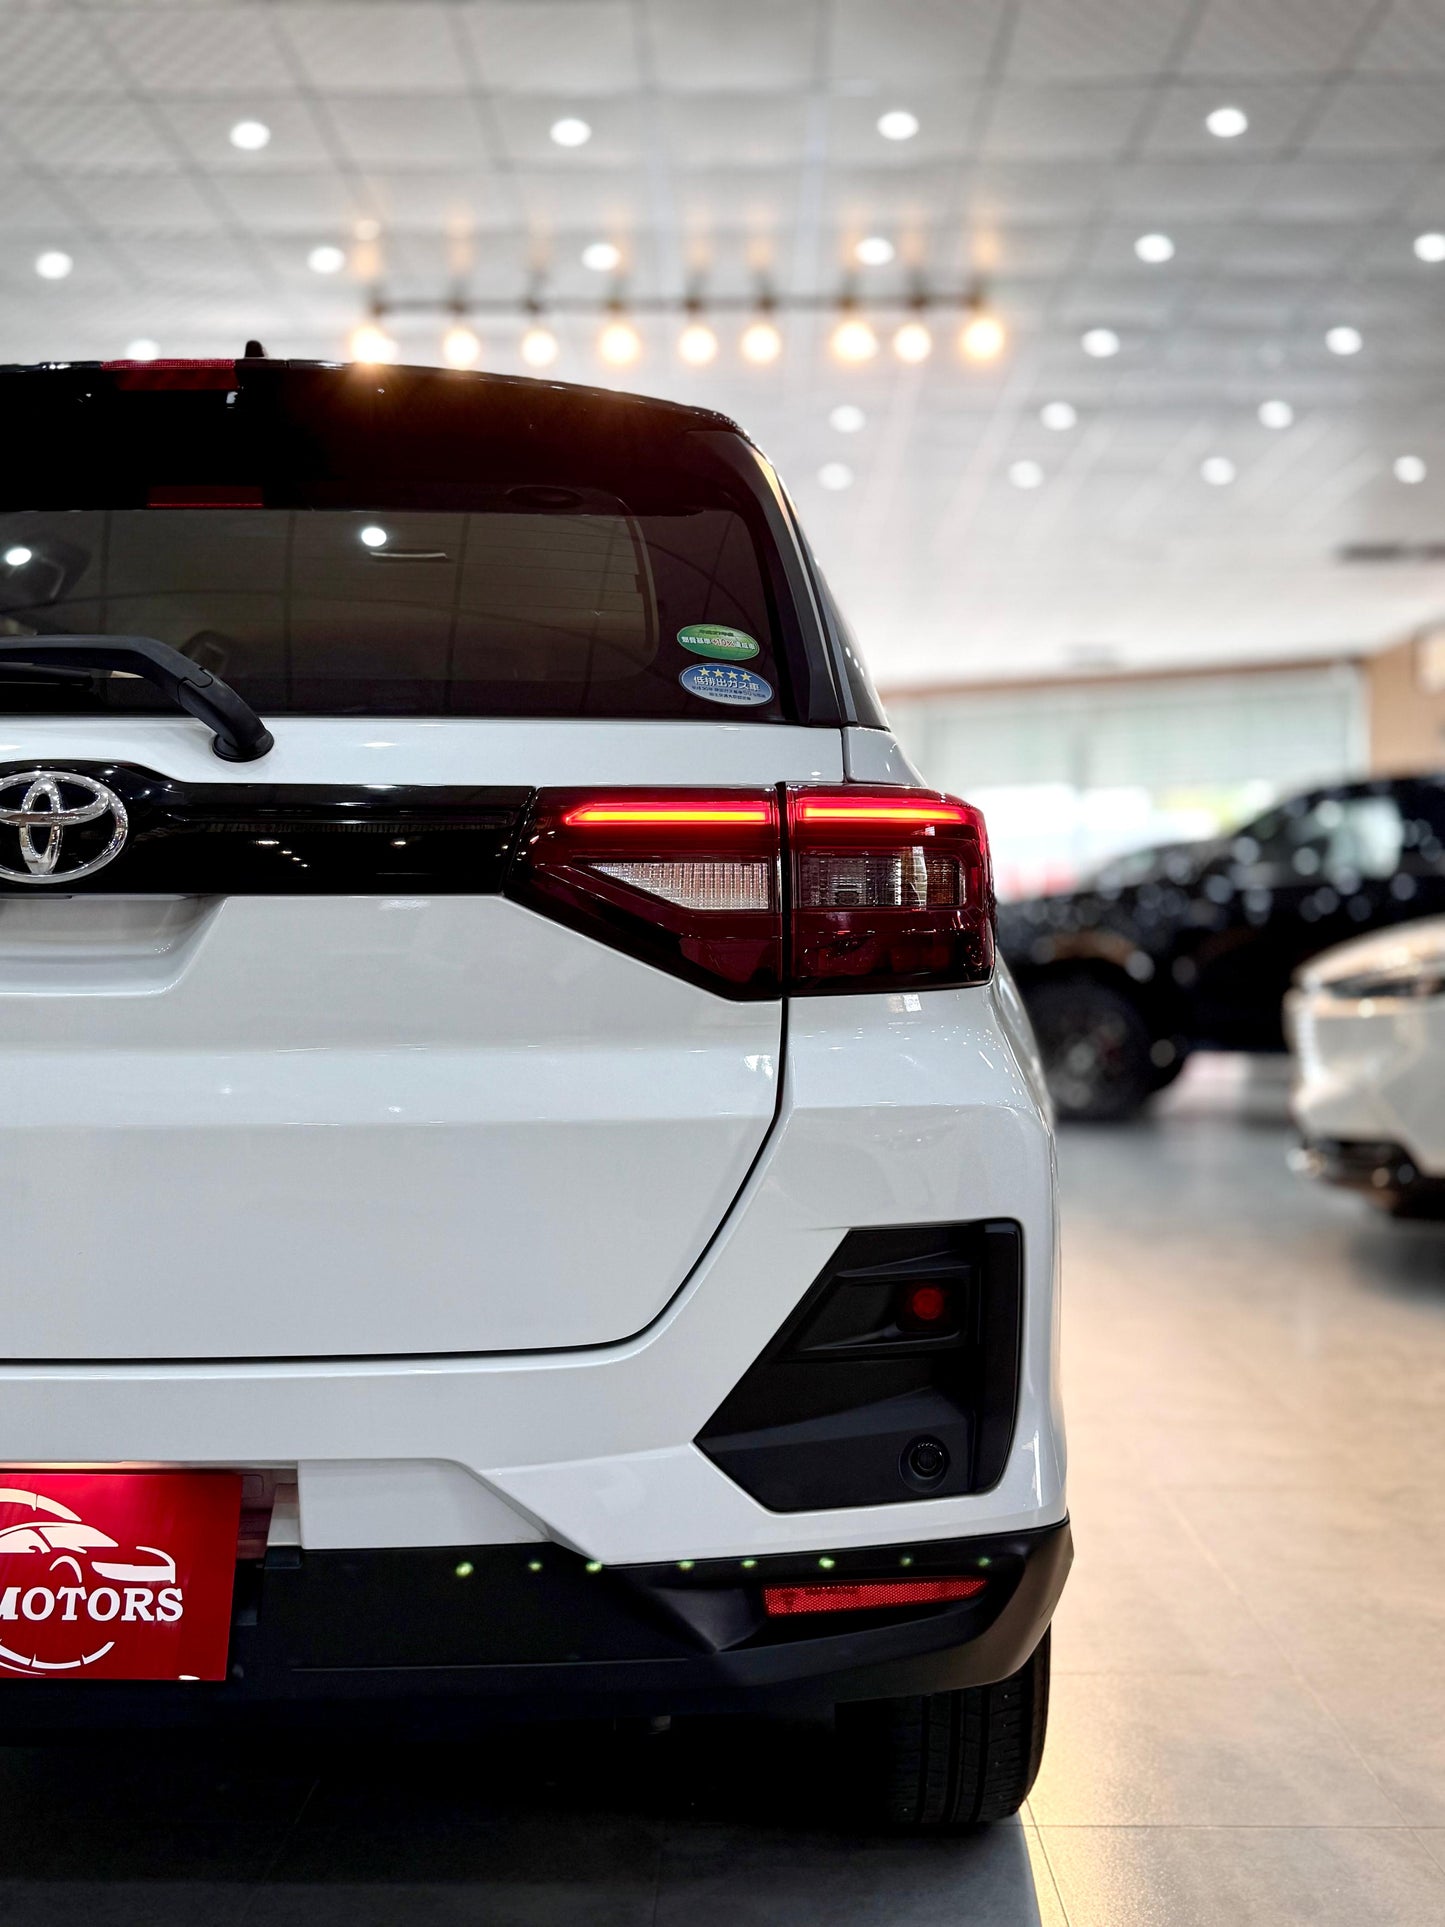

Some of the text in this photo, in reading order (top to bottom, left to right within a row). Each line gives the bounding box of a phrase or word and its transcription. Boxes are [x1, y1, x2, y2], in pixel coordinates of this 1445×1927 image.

[693, 676, 760, 691] 低排出ガス車
